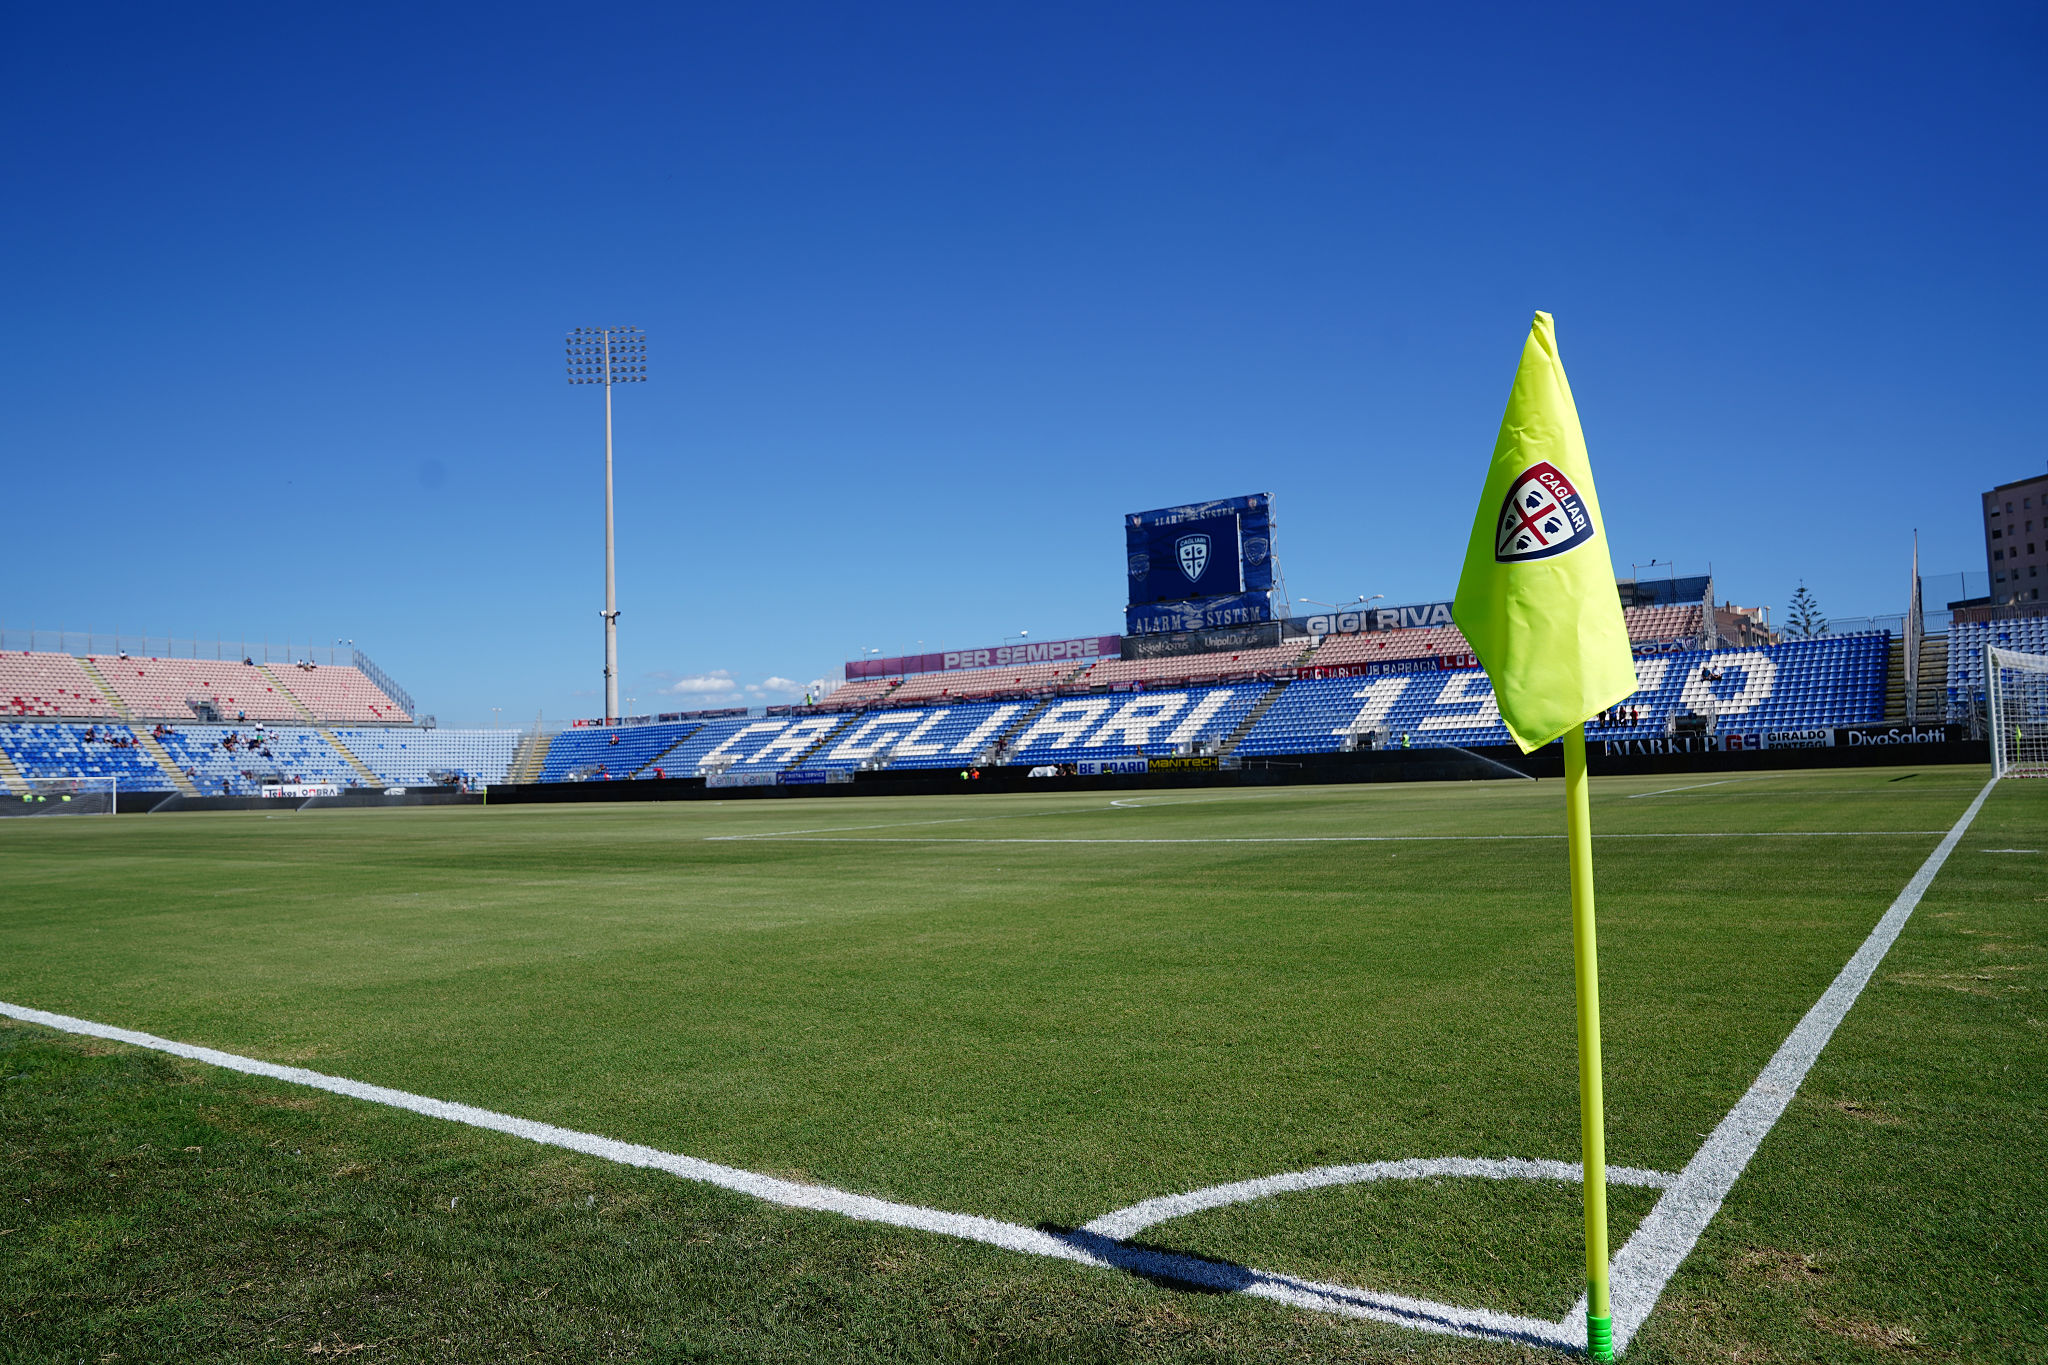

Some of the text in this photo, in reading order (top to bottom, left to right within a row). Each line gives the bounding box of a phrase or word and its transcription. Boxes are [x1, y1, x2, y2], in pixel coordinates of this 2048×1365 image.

[1539, 472, 1587, 533] CAGLIARI
[1154, 506, 1236, 527] ALARM SYSTEM
[1179, 537, 1207, 548] CAGLIARI
[1135, 606, 1261, 633] ALARM SYSTEM
[1306, 604, 1454, 636] GIGI RIVA
[943, 639, 1100, 669] PER SEMPRE
[1352, 664, 1380, 677] CLUB
[697, 690, 1235, 766] CAGLIARI
[1768, 730, 1826, 742] GIRALDO
[1848, 727, 1945, 745] DivaSalotti
[1079, 763, 1095, 774] BE
